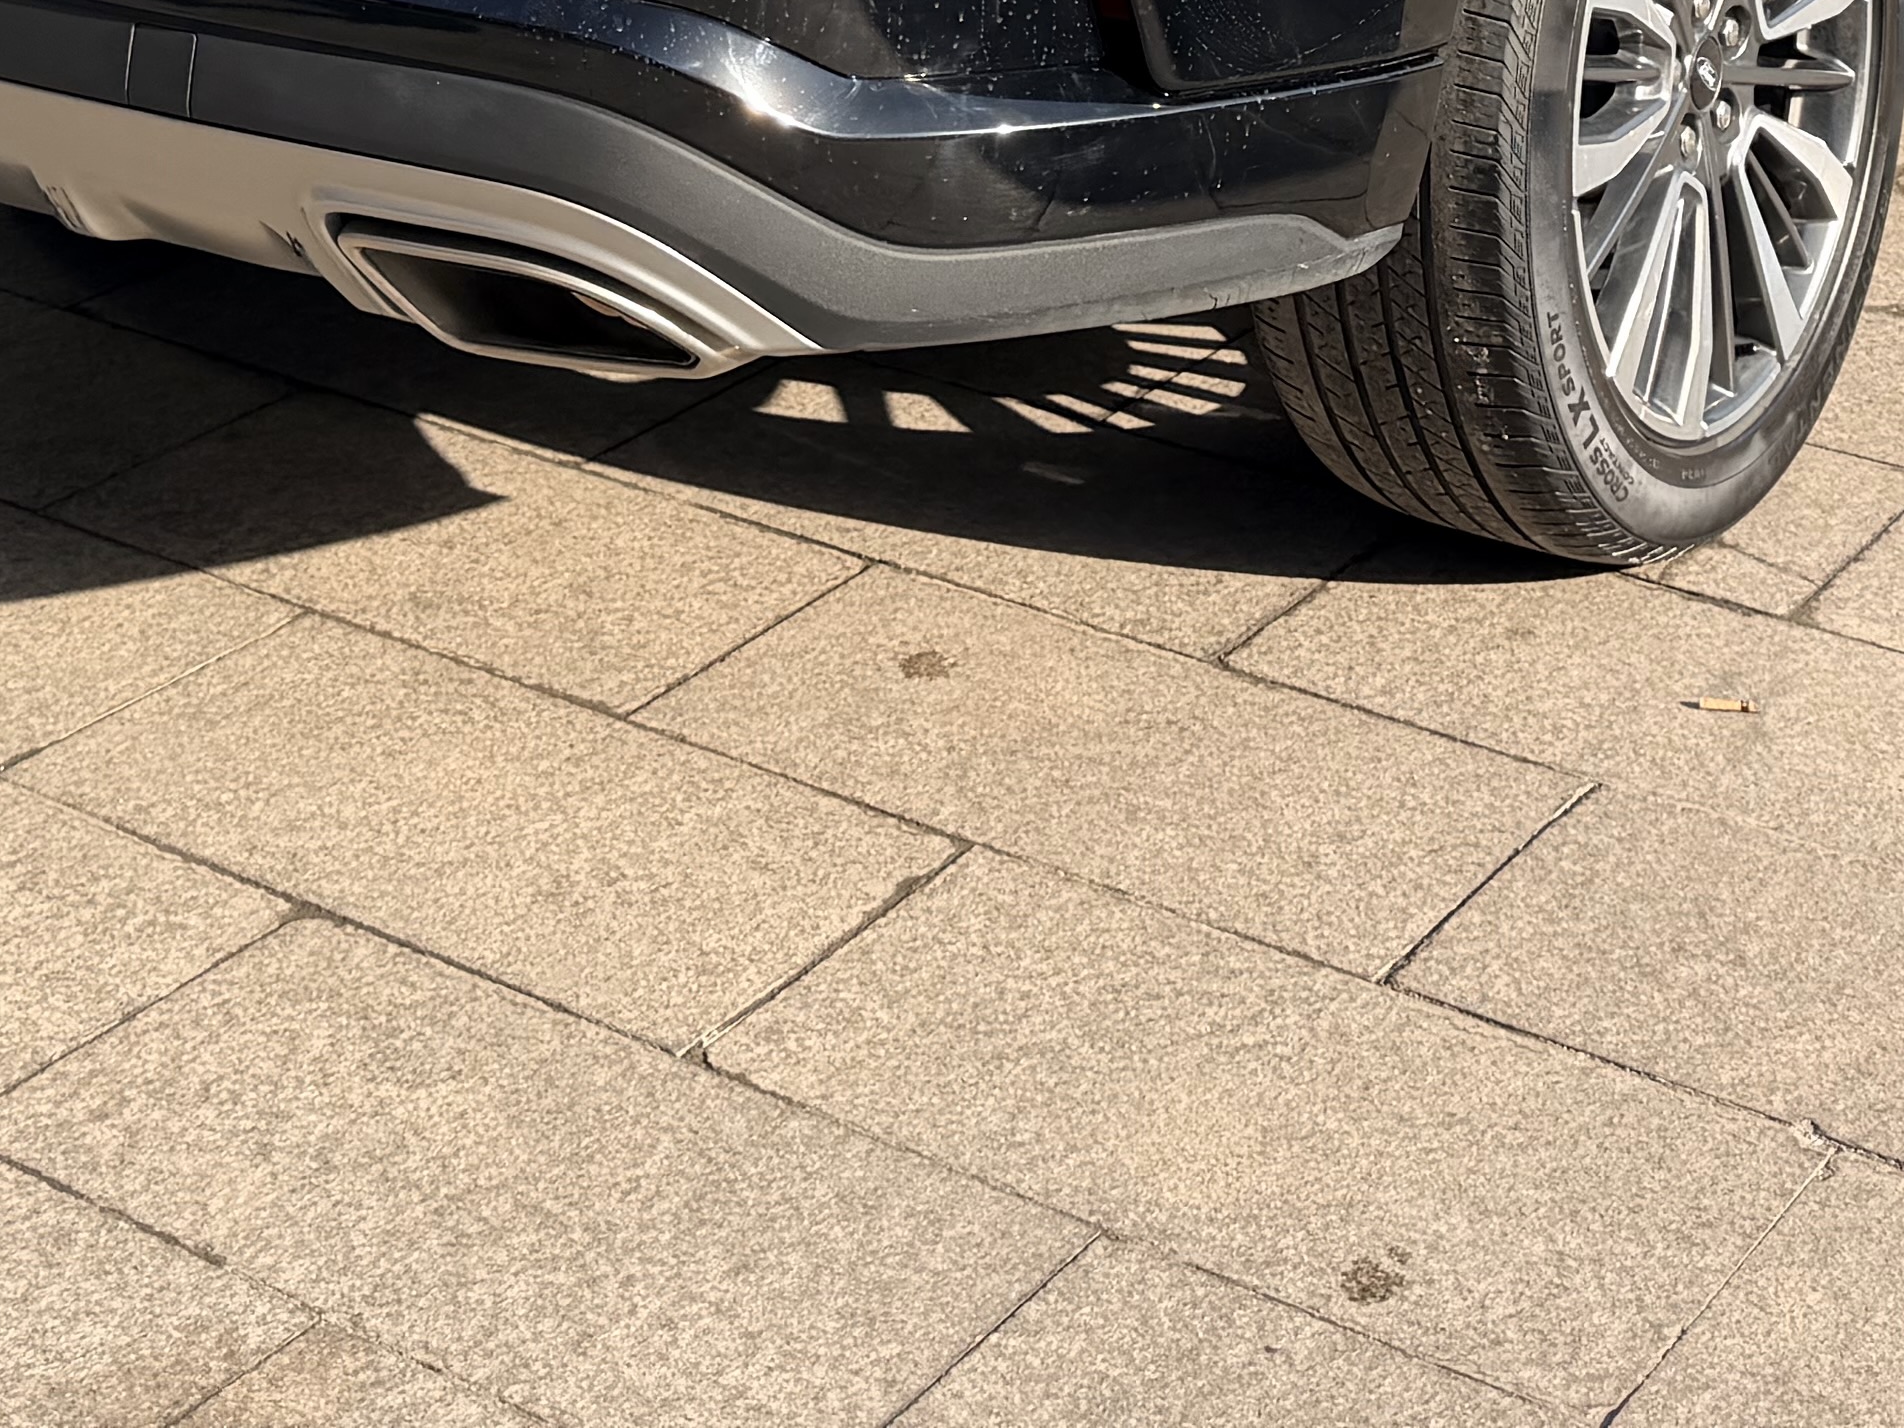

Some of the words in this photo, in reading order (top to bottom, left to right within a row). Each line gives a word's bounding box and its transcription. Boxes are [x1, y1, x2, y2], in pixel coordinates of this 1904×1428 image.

[1546, 311, 1576, 397] SPORT
[1567, 385, 1601, 450] LX
[1589, 446, 1630, 503] CROSS
